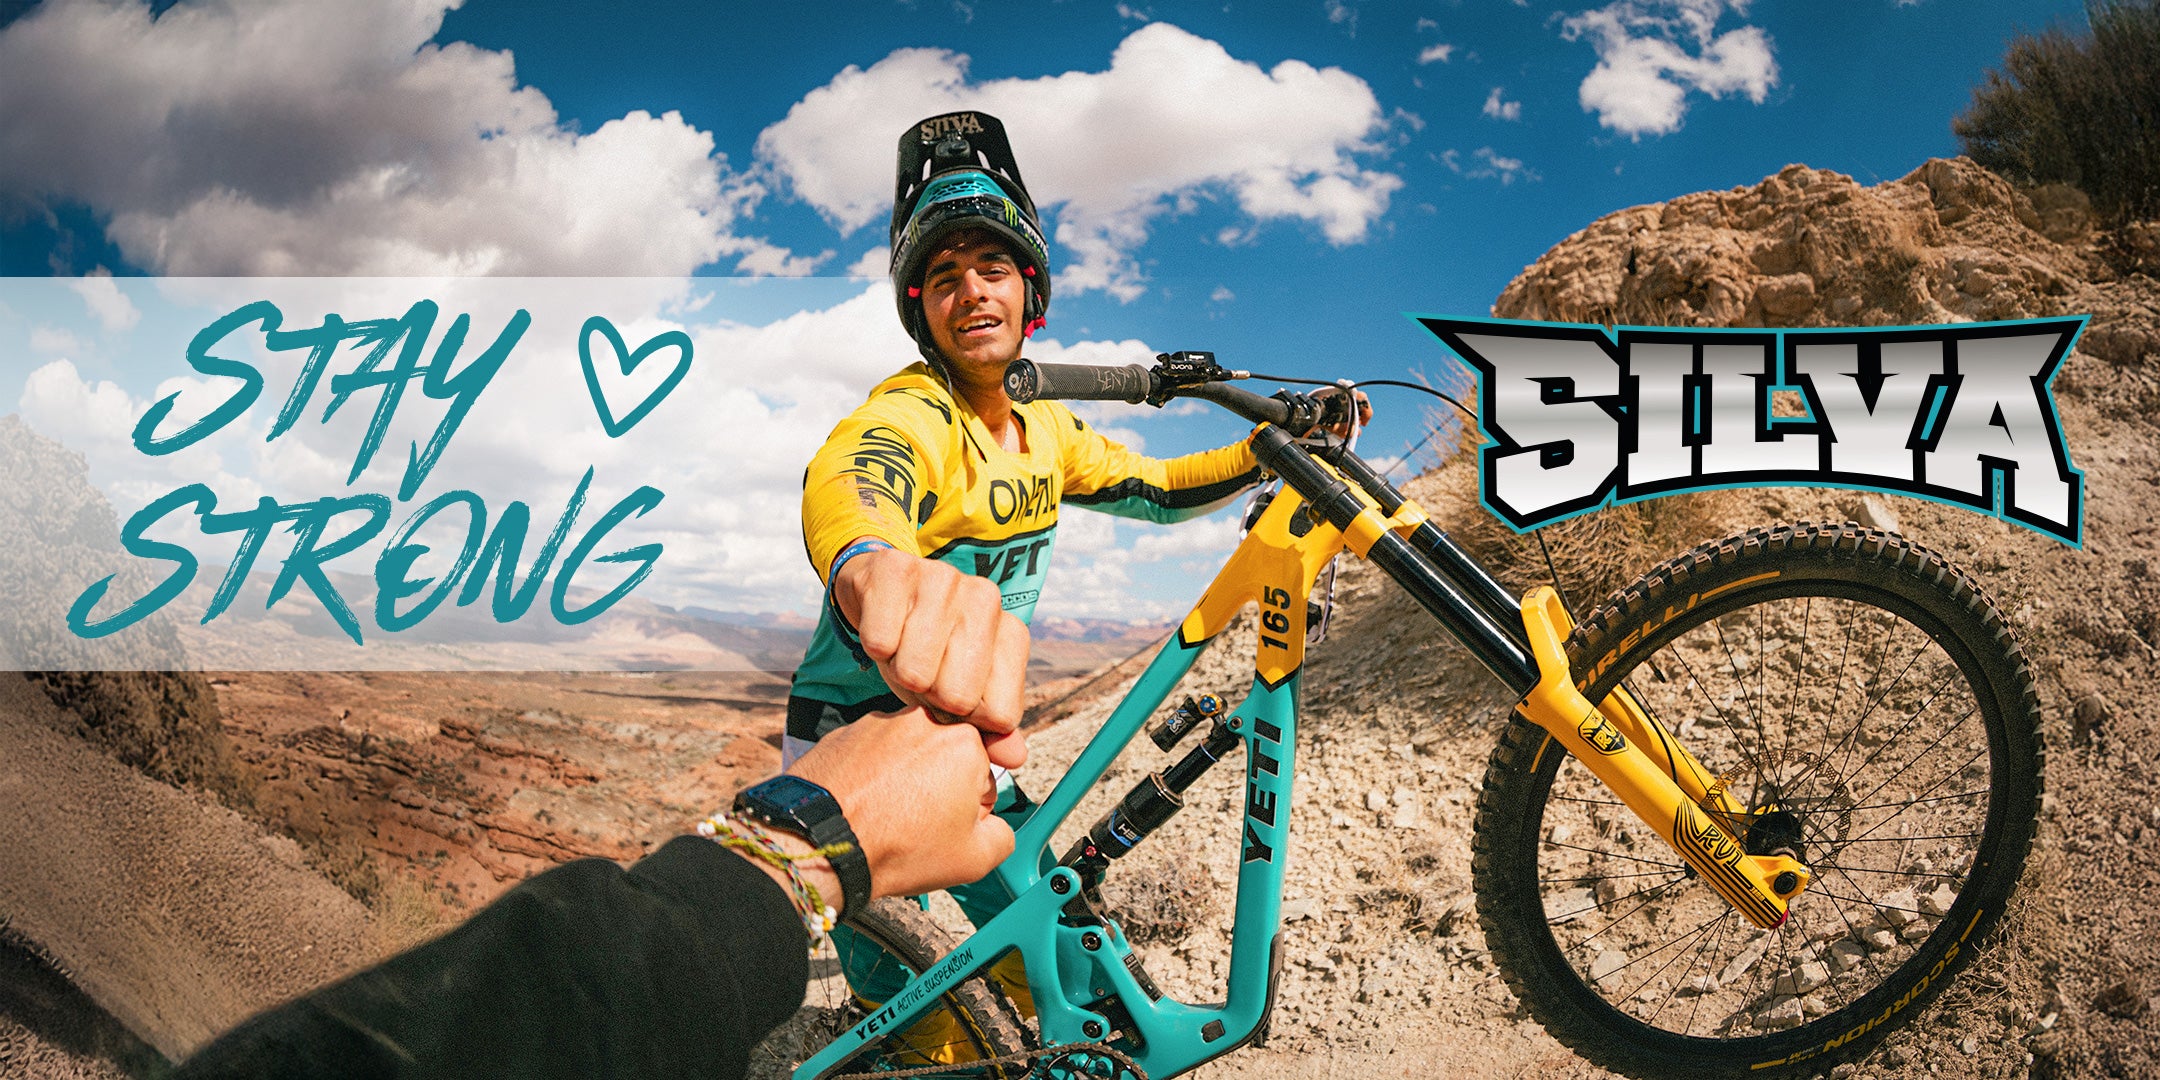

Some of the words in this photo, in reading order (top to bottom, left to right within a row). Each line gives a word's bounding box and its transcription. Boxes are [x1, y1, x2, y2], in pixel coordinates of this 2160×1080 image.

[974, 538, 1050, 586] YET
[1261, 585, 1291, 651] 165
[1244, 717, 1282, 865] YETI
[855, 1006, 896, 1041] YETI
[897, 985, 925, 1013] ACTIVE
[1822, 941, 1961, 1053] SCORPION
